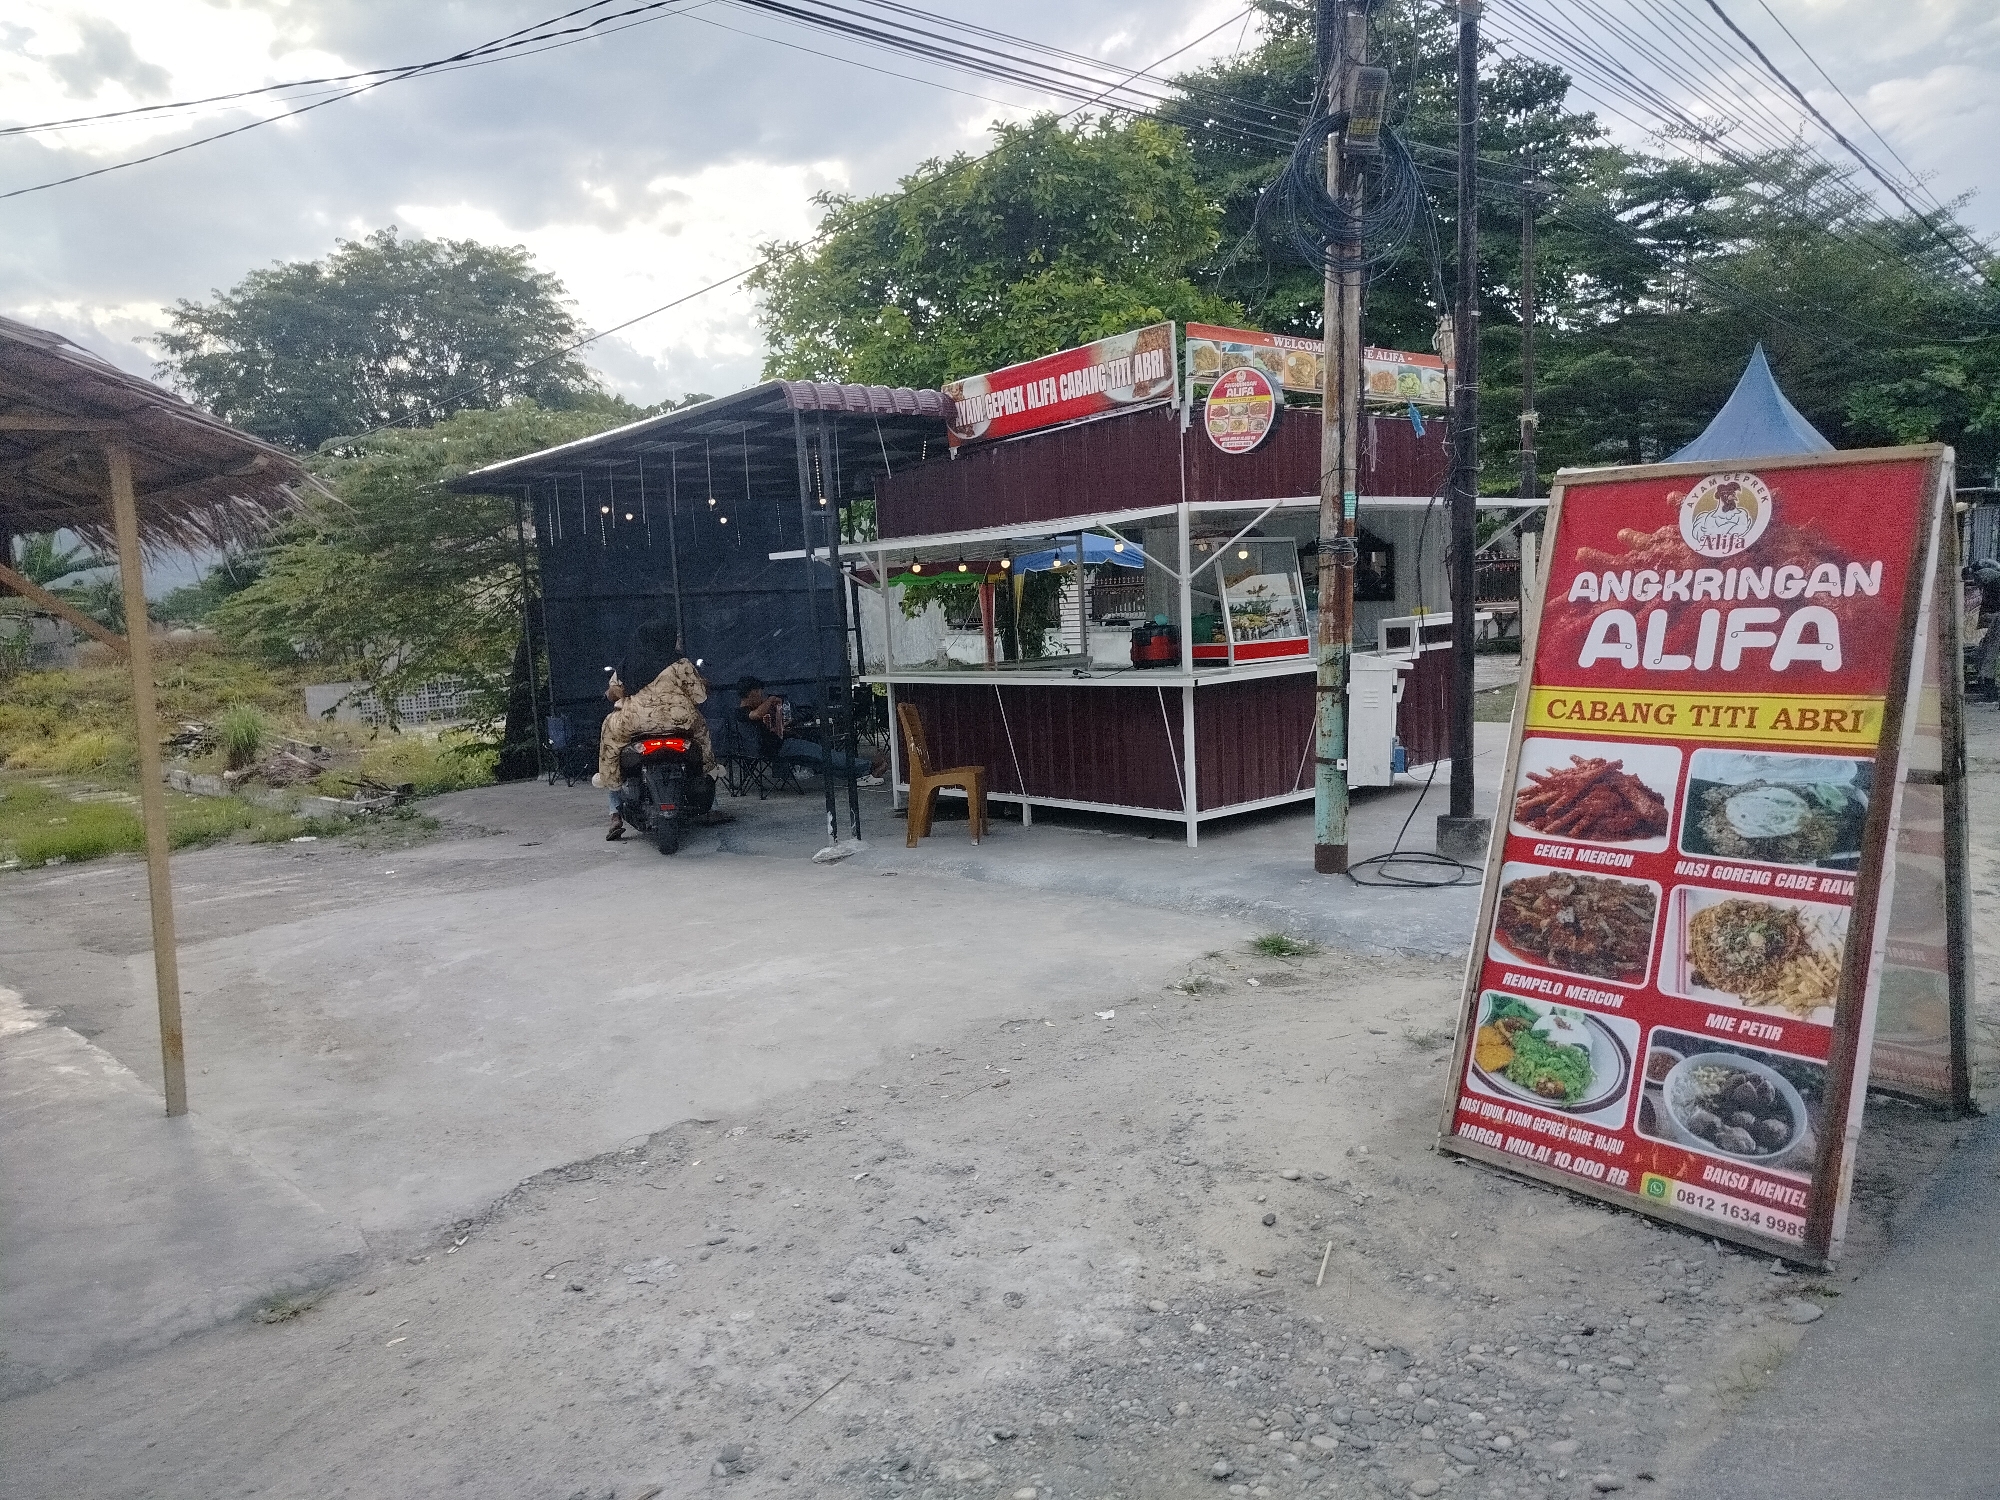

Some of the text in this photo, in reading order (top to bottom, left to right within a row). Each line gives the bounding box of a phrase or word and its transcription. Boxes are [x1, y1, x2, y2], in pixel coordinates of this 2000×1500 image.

[1376, 350, 1405, 363] ALIFA
[984, 385, 1026, 421] GEPREK
[1026, 376, 1058, 410] ALIFA
[1059, 363, 1107, 400] CABANG
[1108, 356, 1132, 390] TITI
[1134, 348, 1165, 383] ABRI
[1686, 473, 1769, 508] AYAM GEPREK
[1695, 532, 1746, 555] Alifa
[1568, 560, 1883, 602] ANGKRINGAN
[1578, 605, 1842, 672] ALIFA
[1547, 697, 1867, 733] CABANG TITI ABRI
[1533, 843, 1635, 868] CEKER MERCON
[1673, 860, 1710, 878] NASI
[1712, 865, 1772, 886] GORENG
[1774, 873, 1817, 891] CABE
[1502, 972, 1625, 1009] REMPELO MERCON
[1705, 1012, 1784, 1041] MIE PETIR
[1459, 1096, 1625, 1155] NASI UDUK AYAM GEPREK CABE HIJAU
[1458, 1122, 1630, 1187] HARGA MULAI 10.000 RB
[1702, 1165, 1750, 1191] BAKSO
[1676, 1188, 1715, 1212] 0812
[1720, 1202, 1761, 1226] 1634
